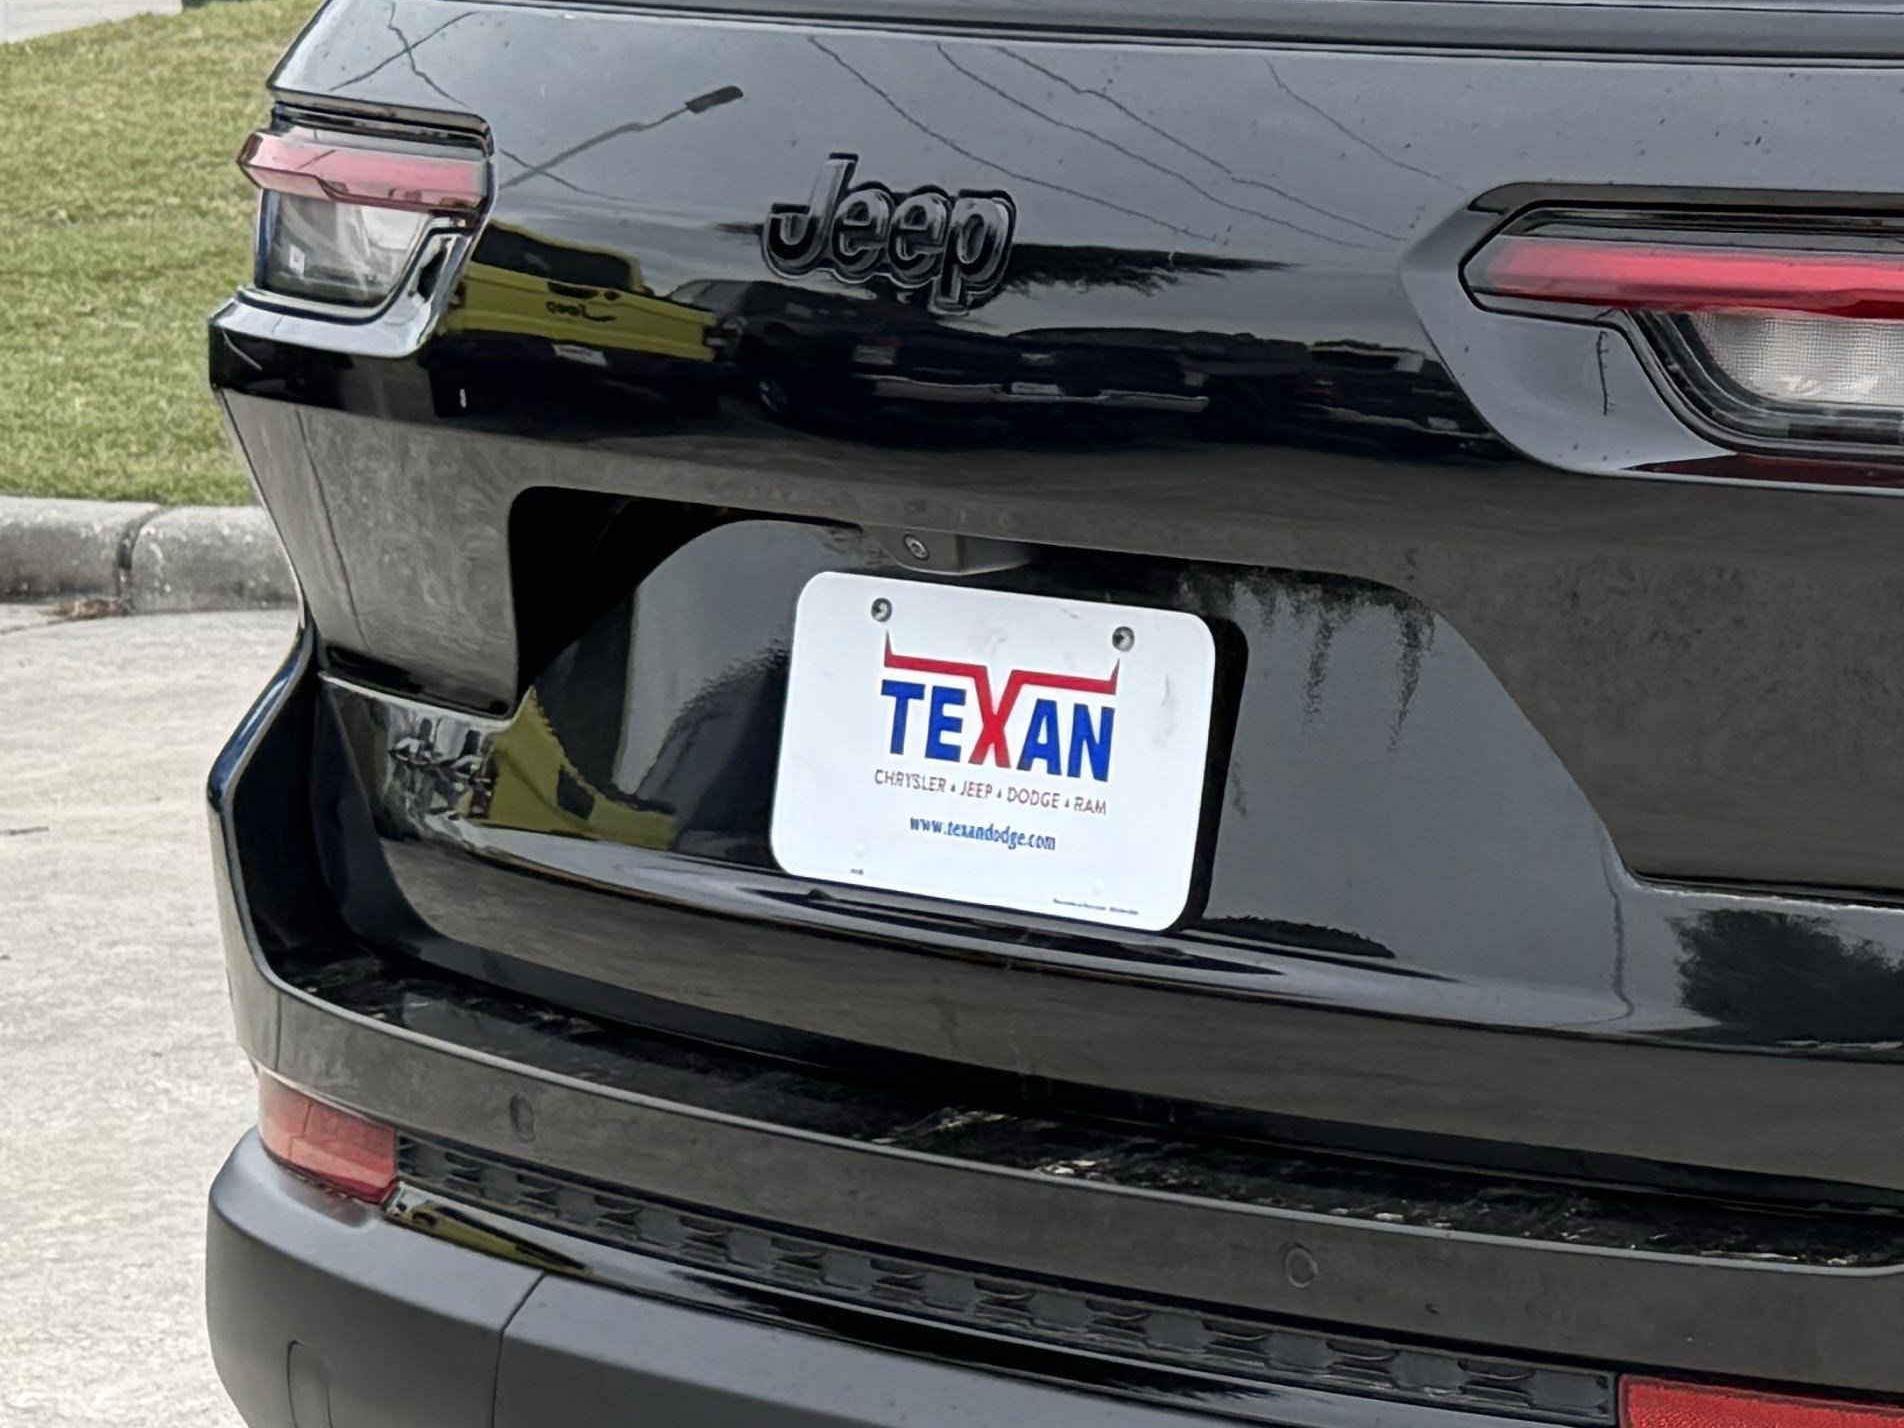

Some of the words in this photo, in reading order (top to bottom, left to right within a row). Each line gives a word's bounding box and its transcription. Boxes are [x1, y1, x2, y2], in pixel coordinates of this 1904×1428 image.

[761, 152, 1017, 317] Jeep
[881, 630, 1120, 782] TEXAN
[874, 768, 947, 792] CHRYSLER
[960, 779, 993, 800] JEEP
[1006, 786, 1061, 809] DODGE
[1073, 795, 1107, 816] RAM
[909, 816, 1056, 851] www.texandodge.com
